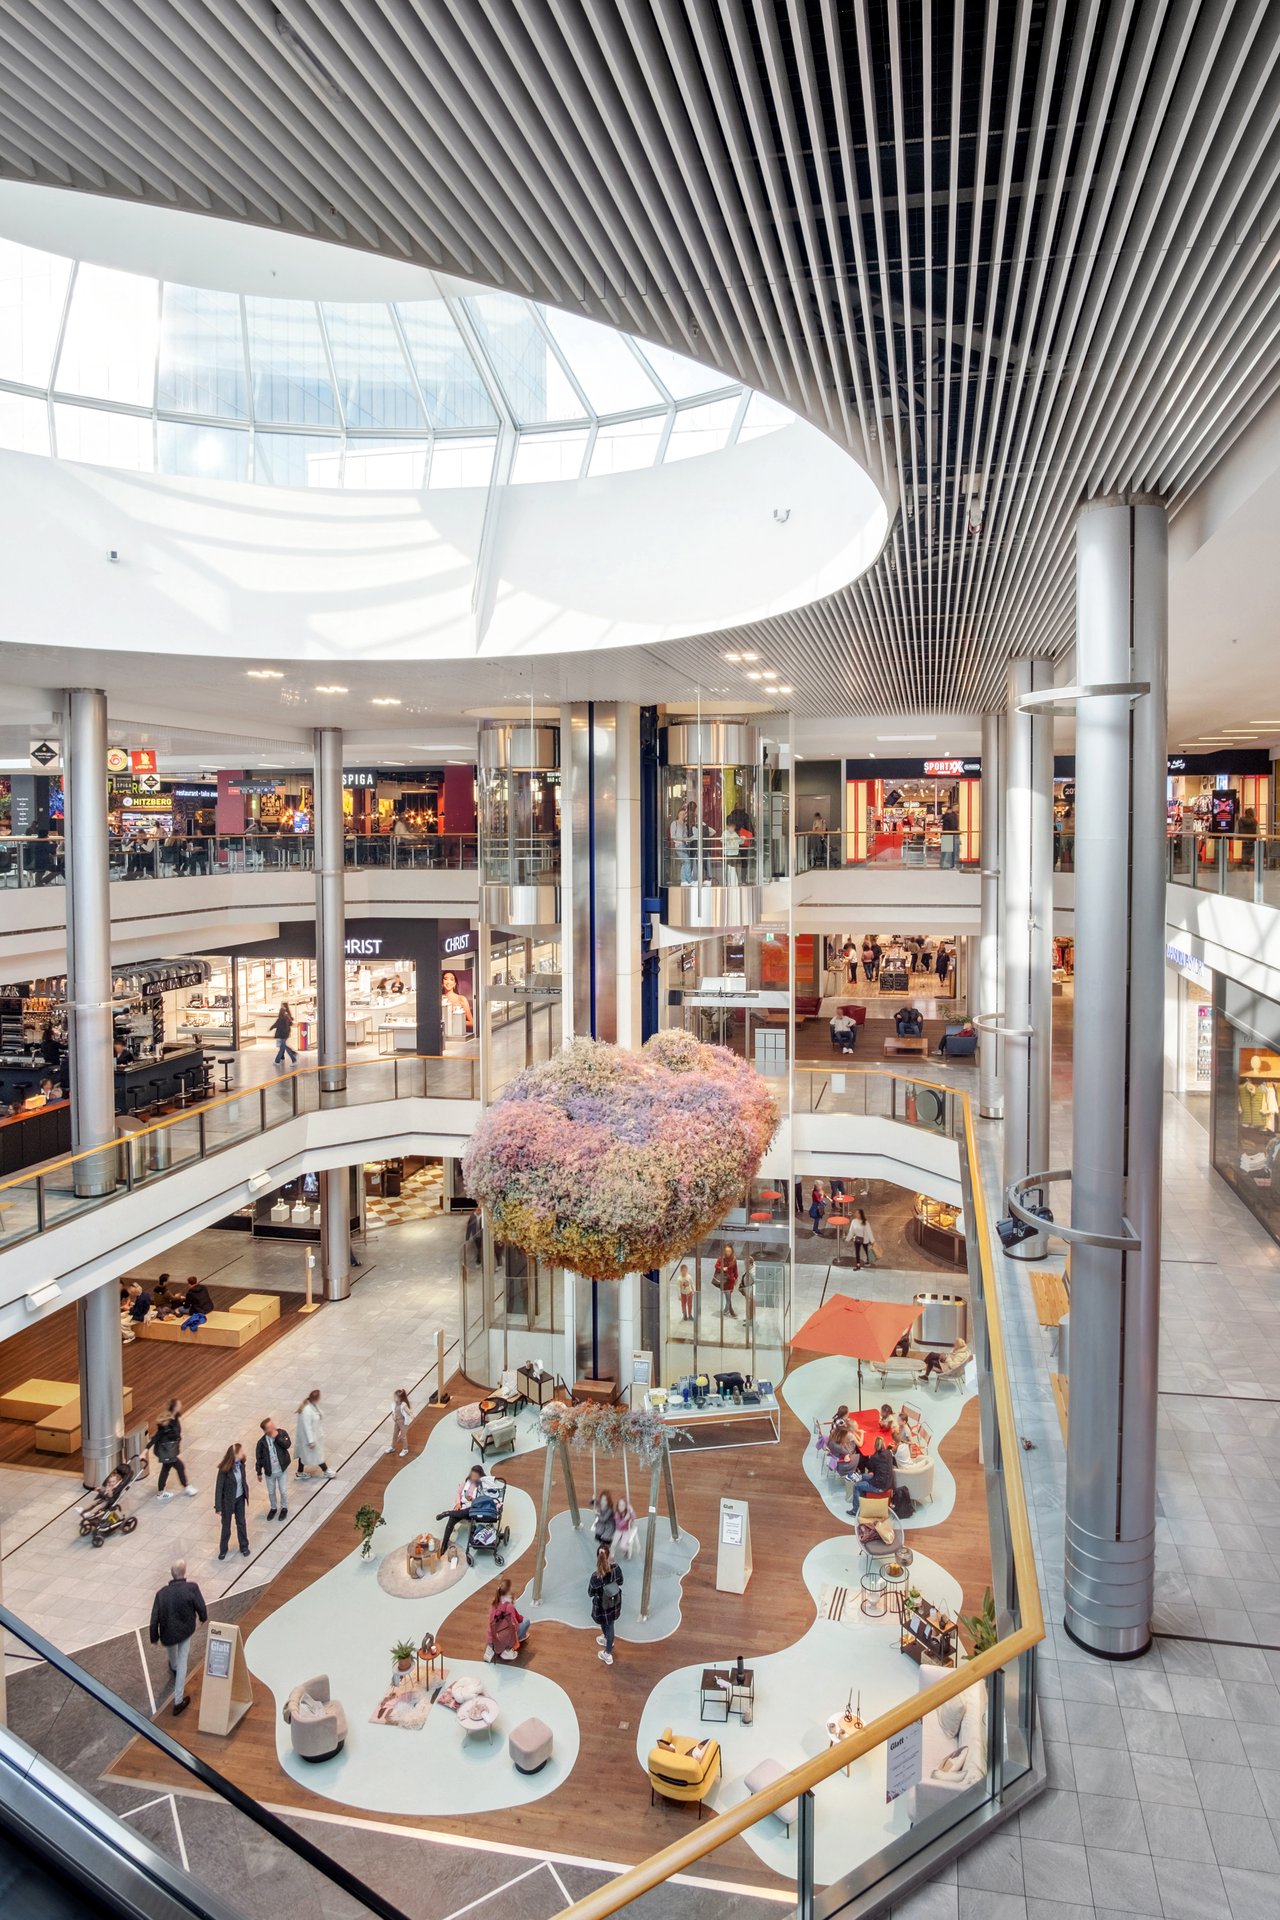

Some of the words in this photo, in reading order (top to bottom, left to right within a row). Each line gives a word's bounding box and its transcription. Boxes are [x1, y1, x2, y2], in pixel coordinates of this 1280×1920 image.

[923, 761, 965, 774] SPORTXX
[342, 774, 373, 785] SPIGA
[345, 939, 382, 954] HRIST
[445, 934, 469, 953] CHRIST
[211, 1642, 230, 1653] Glatt
[890, 1737, 904, 1750] Glatt
